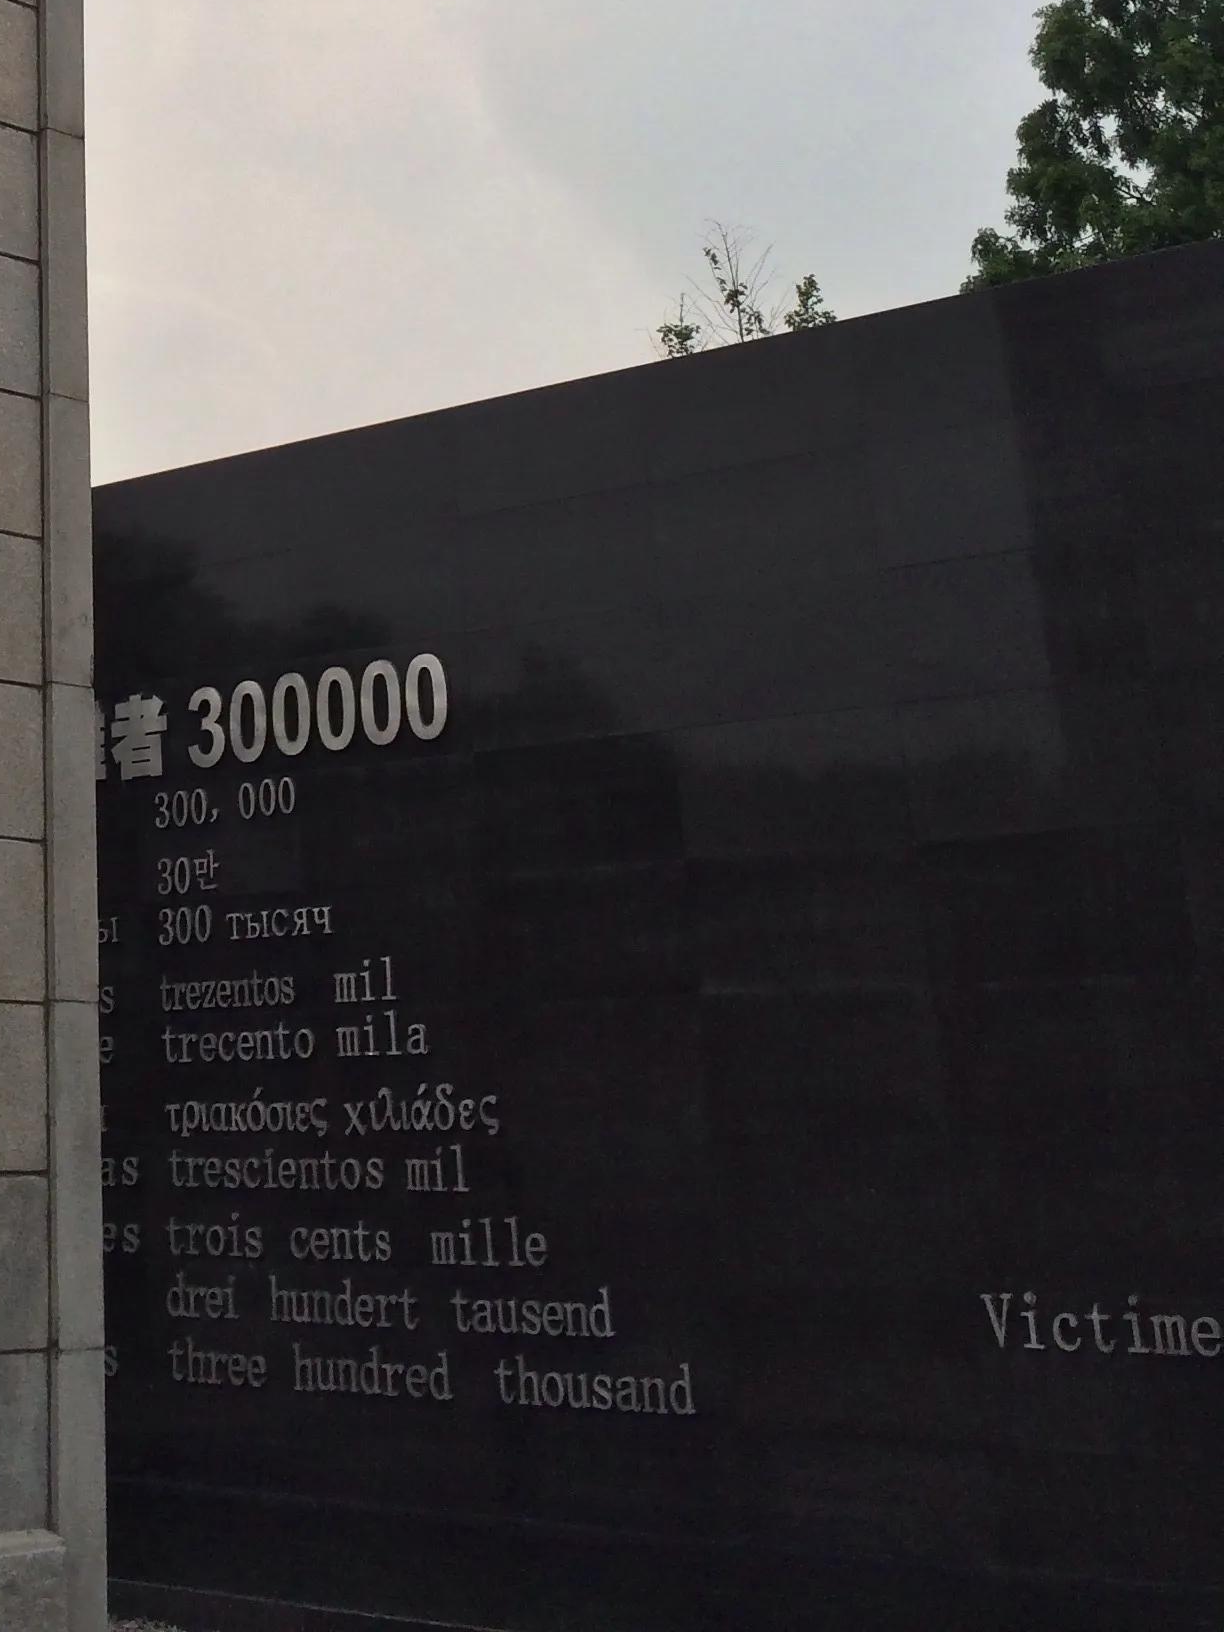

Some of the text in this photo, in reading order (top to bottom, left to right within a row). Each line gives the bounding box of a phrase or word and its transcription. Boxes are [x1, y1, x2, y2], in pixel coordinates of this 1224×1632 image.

[188, 652, 448, 768] 300000
[158, 904, 213, 946] 300
[225, 905, 333, 940] тысяч
[159, 969, 296, 1012] trezentos
[333, 955, 397, 1003] mil
[161, 1021, 315, 1063] trecento
[335, 1009, 429, 1057] mila
[168, 1147, 384, 1191] trescientos
[404, 1143, 470, 1193] mil
[165, 1211, 263, 1259] trois
[290, 1220, 392, 1262] cents
[430, 1215, 547, 1267] mille
[166, 1271, 616, 1338] drei hundert tausend
[167, 1336, 267, 1388] three
[292, 1342, 454, 1401] hundred
[493, 1354, 697, 1415] thousand
